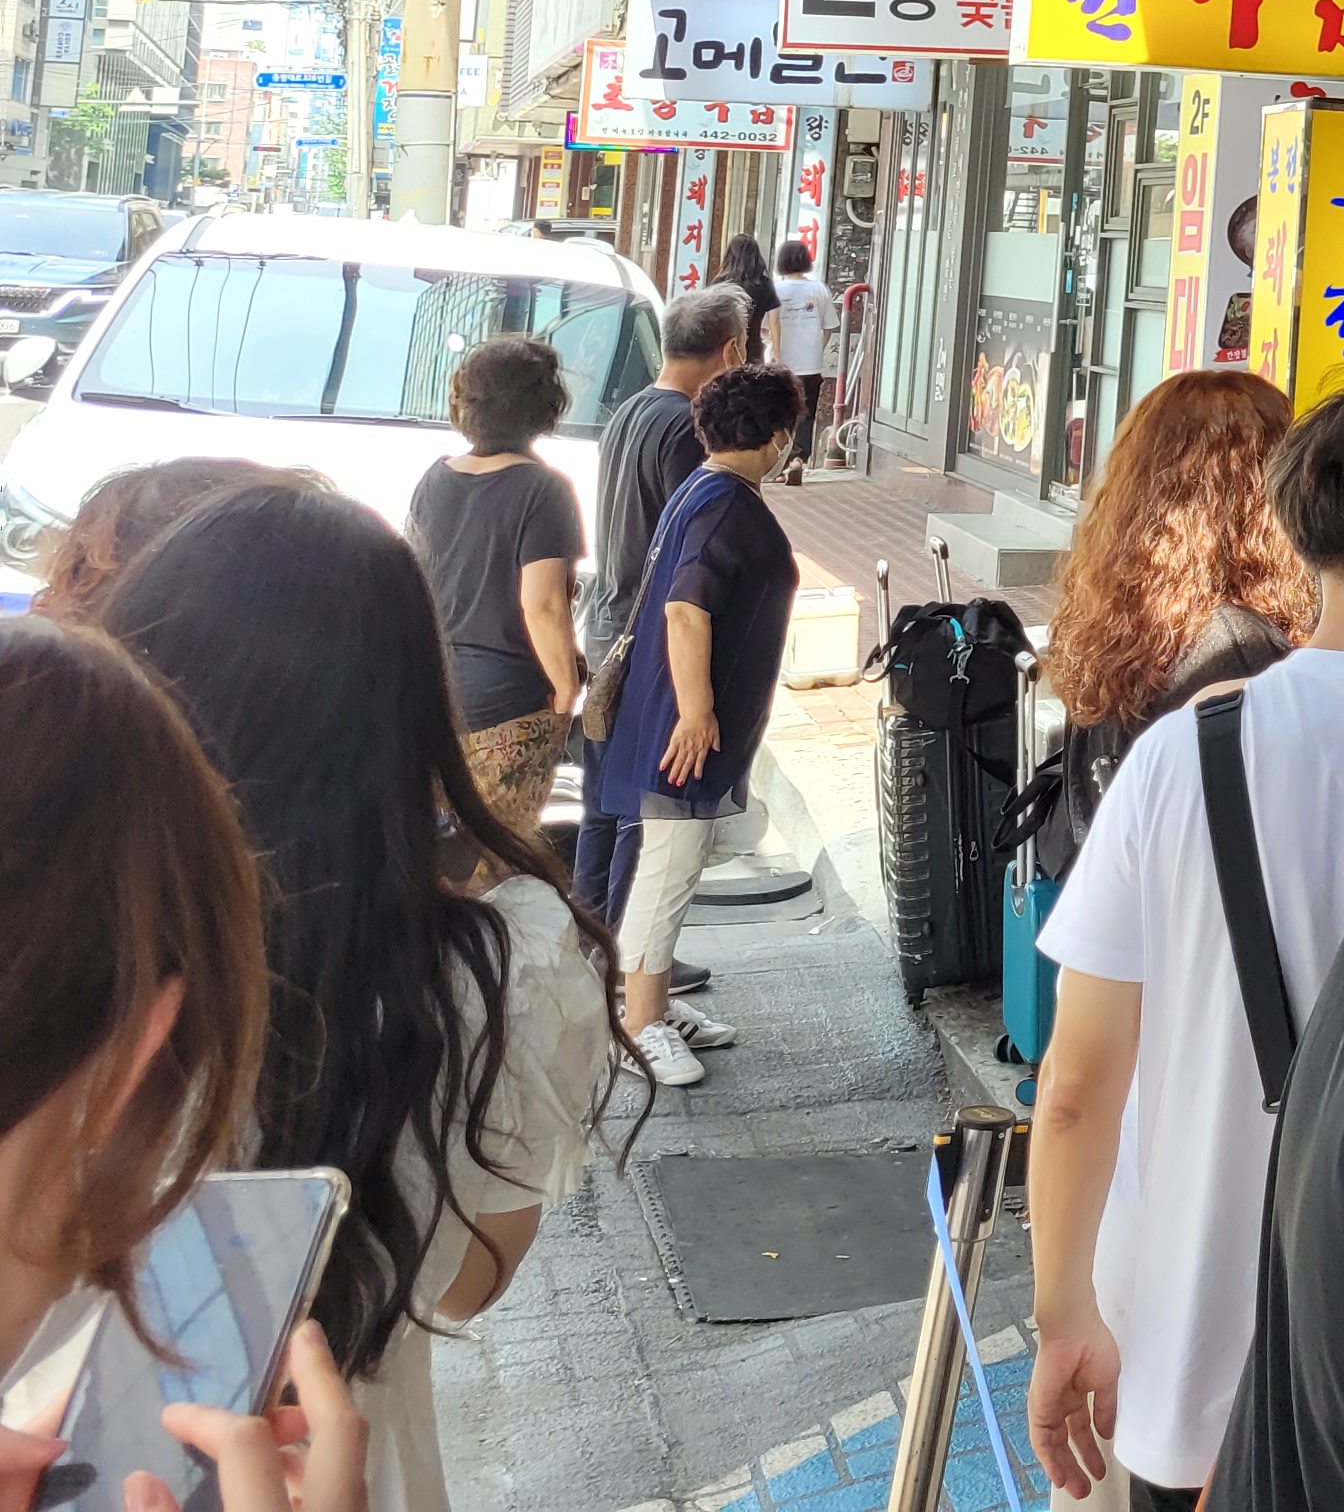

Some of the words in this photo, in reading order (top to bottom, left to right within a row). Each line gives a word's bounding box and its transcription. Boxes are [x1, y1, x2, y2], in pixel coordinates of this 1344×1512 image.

[639, 8, 887, 85] 고메
[699, 130, 777, 142] 442-0032
[1189, 89, 1211, 135] 2F
[1267, 136, 1298, 195] 본전
[1169, 152, 1208, 372] 임대
